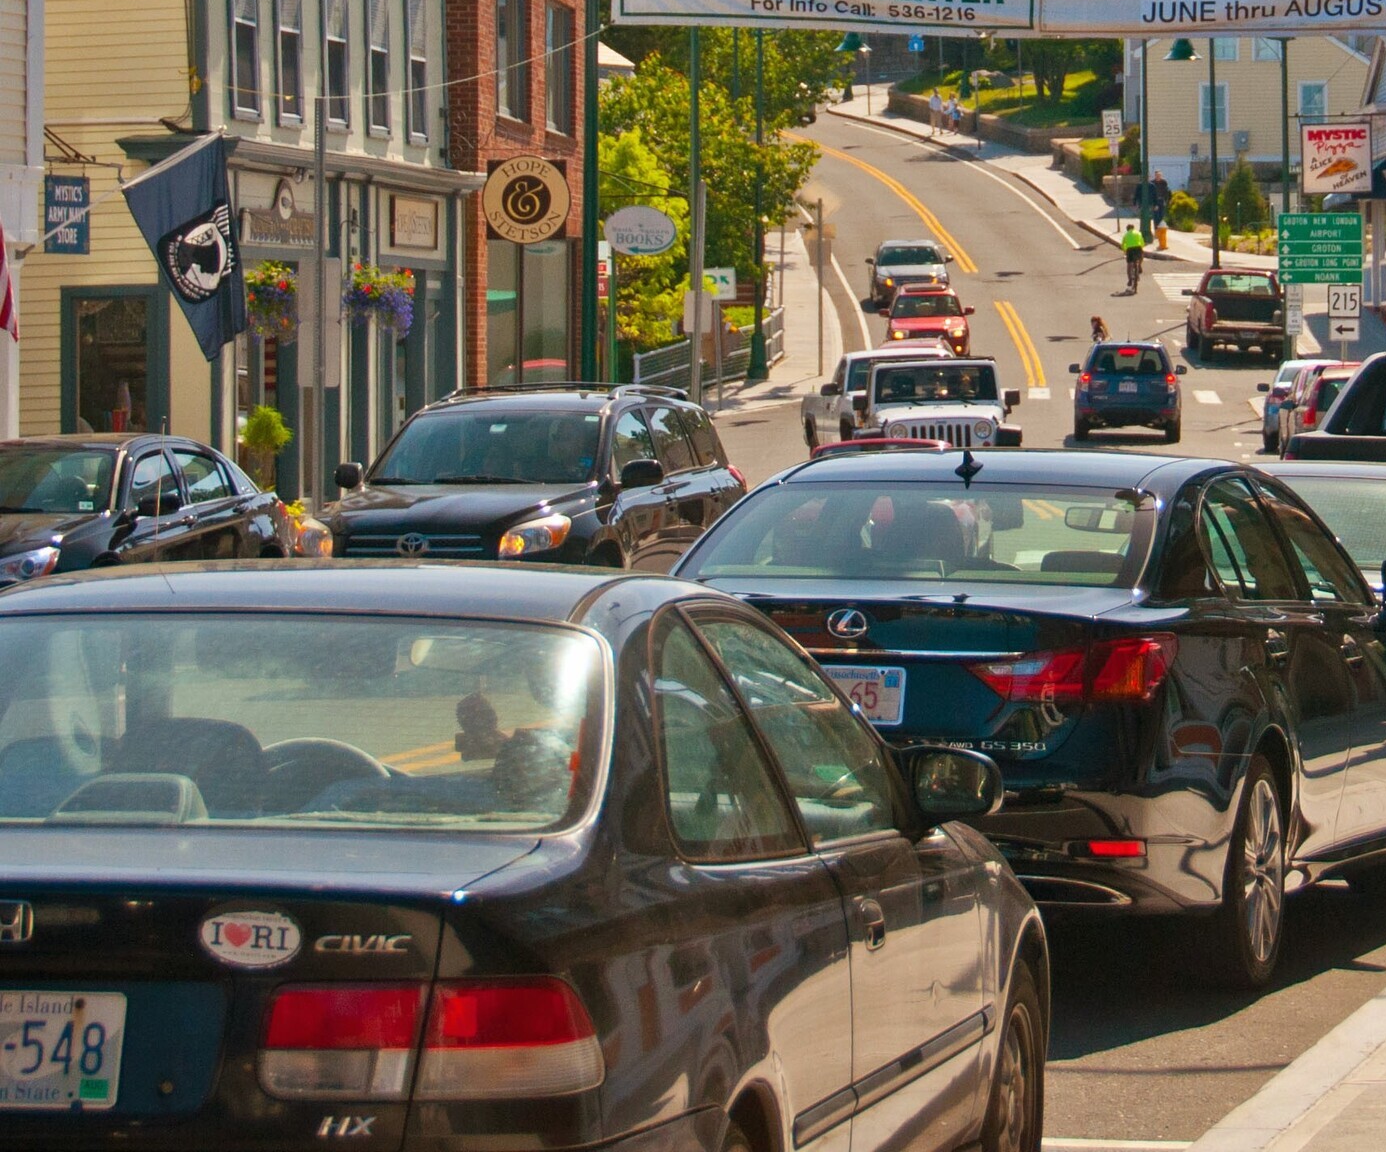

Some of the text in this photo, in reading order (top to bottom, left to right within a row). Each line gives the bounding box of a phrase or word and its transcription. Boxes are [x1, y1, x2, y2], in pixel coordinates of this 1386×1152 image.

[835, 0, 876, 16] Call:
[888, 5, 976, 21] 536-1216
[1142, 1, 1216, 24] JUNE
[1225, 0, 1275, 20] thru
[1105, 125, 1120, 134] 25
[1307, 129, 1367, 141] MYSTIC
[1313, 140, 1364, 155] Pizza
[501, 160, 552, 178] HOPE
[1310, 157, 1332, 171] SLICE
[1333, 170, 1367, 189] HEAVEN
[55, 186, 83, 202] MYSTIC'S
[48, 206, 67, 222] ARMY
[1283, 217, 1357, 225] GROTON NEW LONDON
[489, 210, 562, 240] STETSON
[57, 228, 78, 244] STORE
[616, 233, 664, 245] BOOKS
[1310, 230, 1341, 238] AIRPORT
[1312, 244, 1341, 252] GROTON
[1315, 273, 1340, 281] NOANK
[1332, 292, 1358, 311] 215
[981, 741, 1006, 750] GS
[1010, 741, 1046, 751] 350
[210, 922, 289, 951] I RI
[314, 935, 413, 953] CIVIC
[21, 994, 75, 1014] Island
[15, 1086, 60, 1101] State
[316, 1115, 377, 1136] HX
